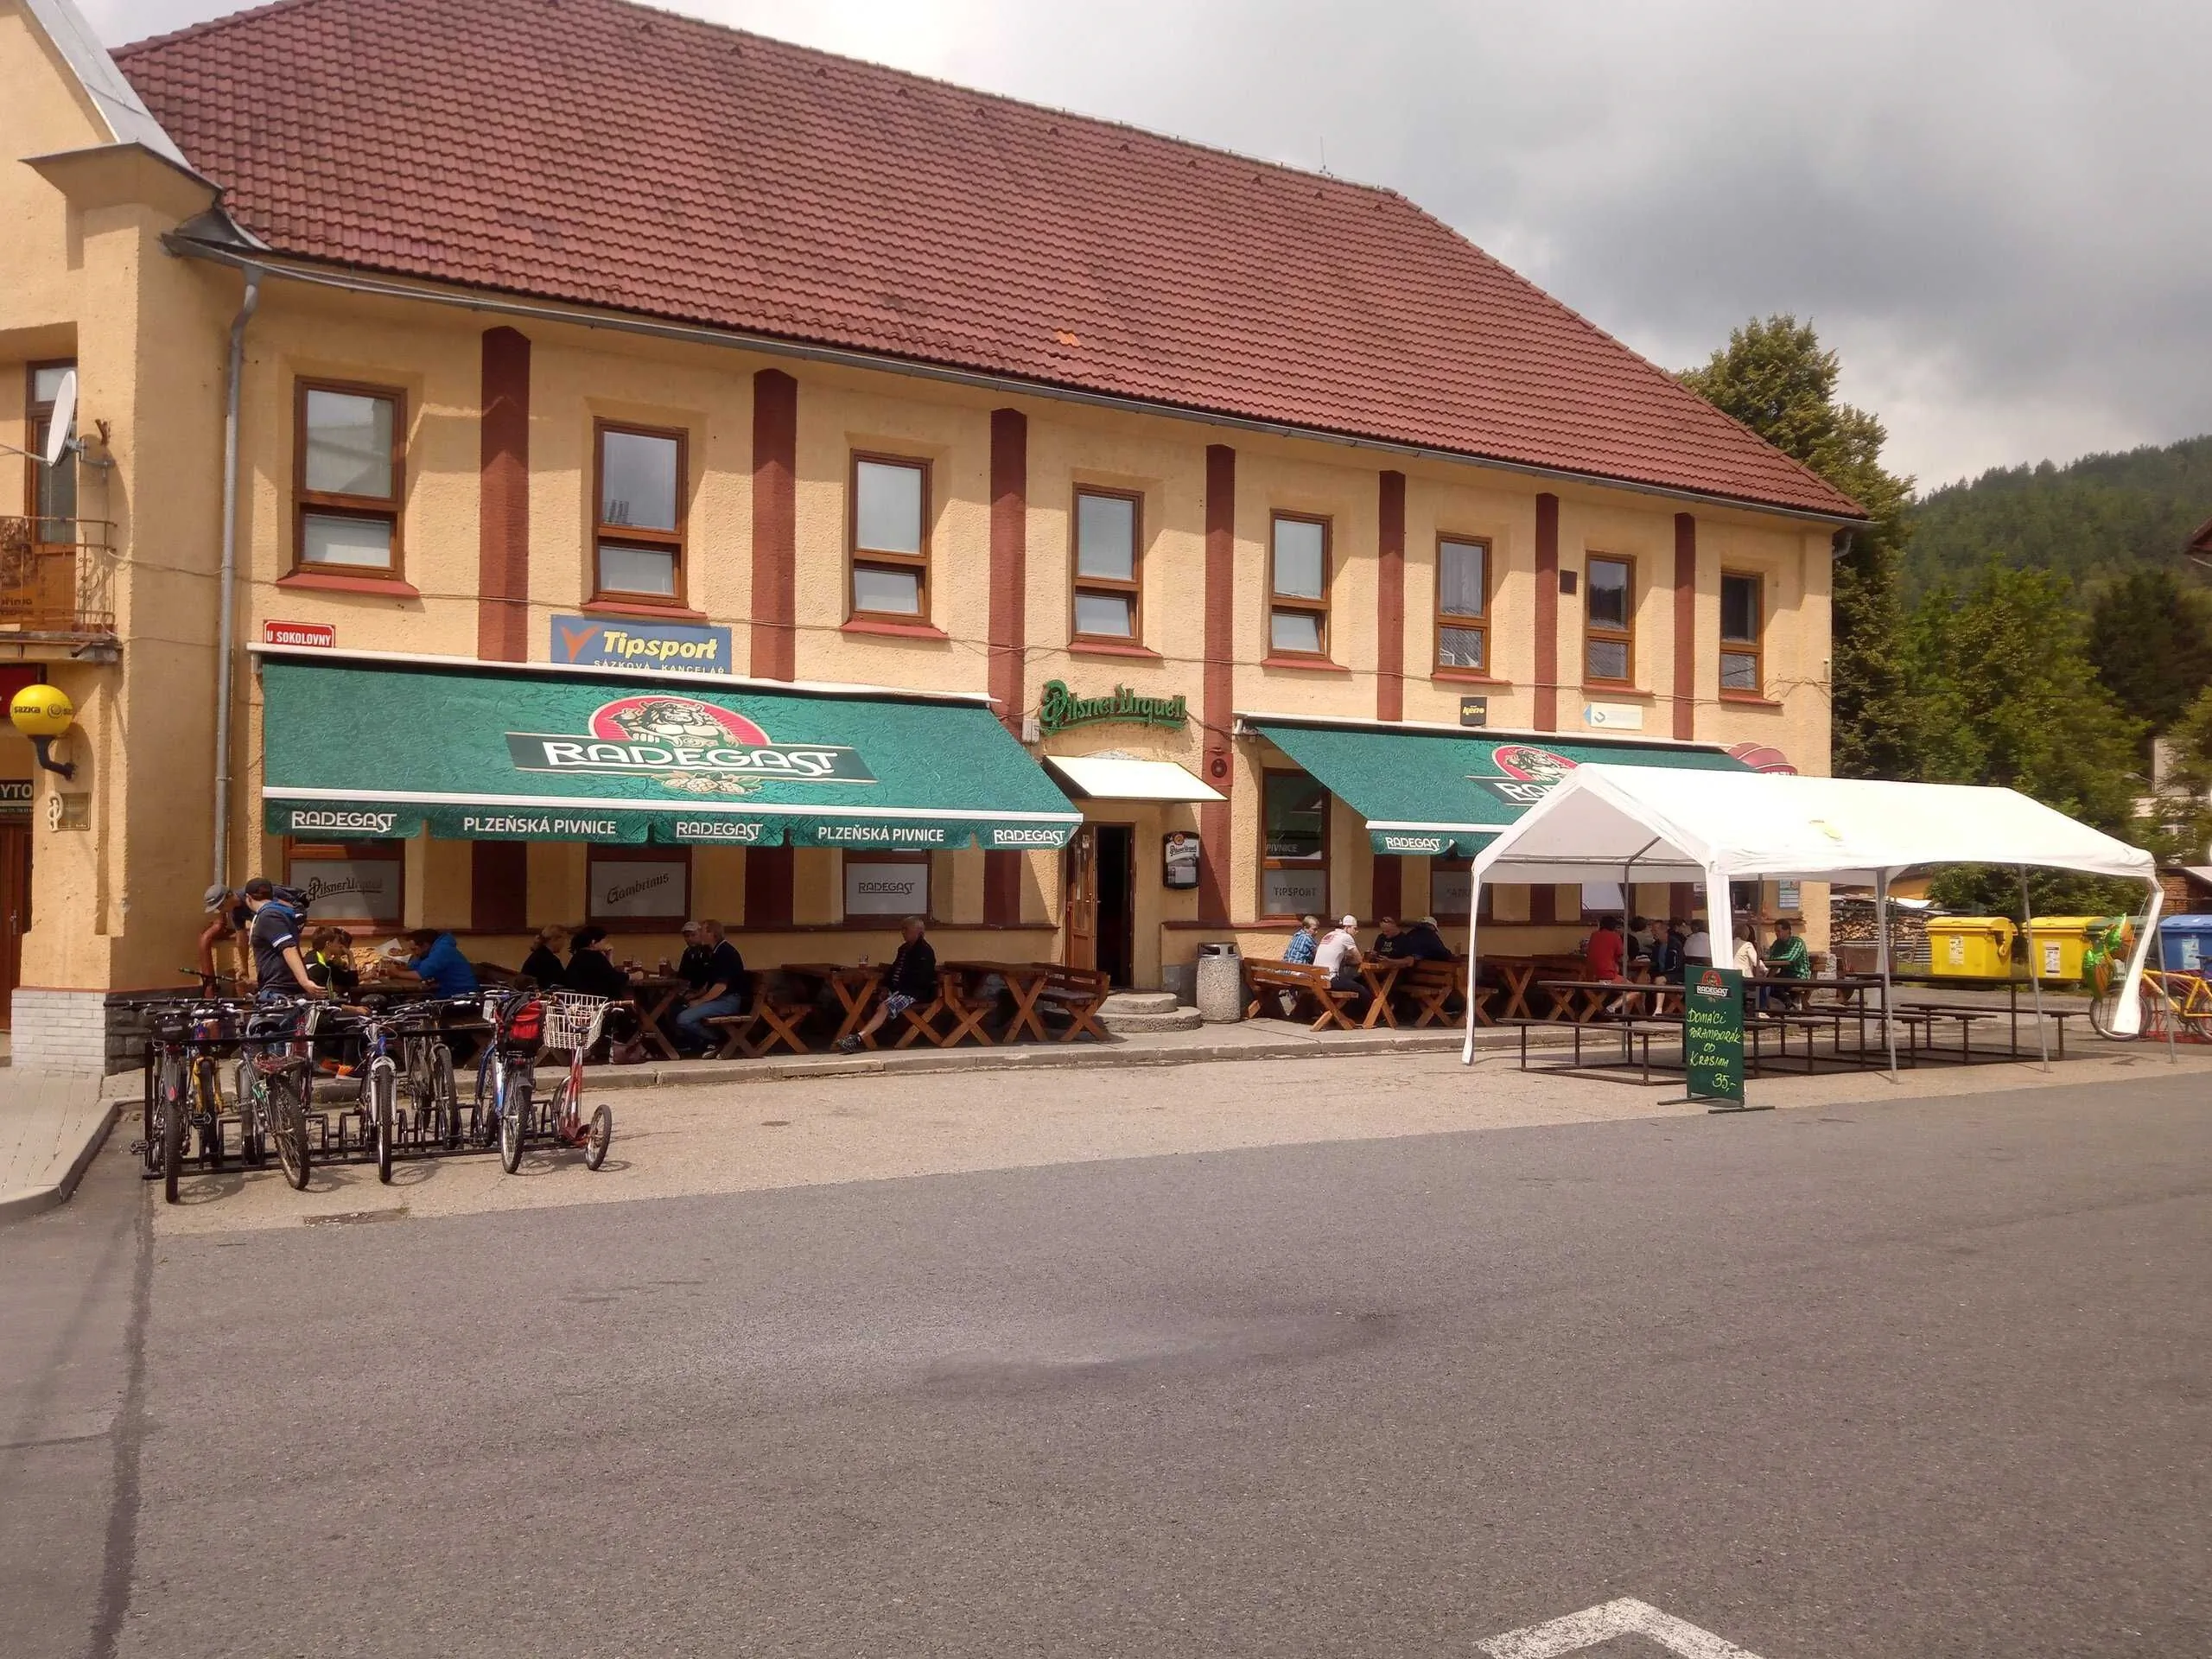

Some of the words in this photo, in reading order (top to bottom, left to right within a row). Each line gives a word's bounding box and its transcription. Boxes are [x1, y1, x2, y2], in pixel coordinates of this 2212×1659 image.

[267, 631, 273, 642] U
[276, 632, 331, 646] SOKOLOVNY
[603, 630, 718, 661] Tipsport
[1040, 679, 1116, 733] Pilsner
[1114, 683, 1187, 726] Urquell
[542, 741, 838, 775] RADEGAST
[291, 811, 397, 833] RADEGAST
[463, 816, 550, 834] PLZEŇSKÁ
[554, 819, 616, 835] PIVNICE
[676, 822, 764, 840] RADEGAST
[818, 825, 890, 842] PLZEŇSKÁ
[893, 828, 944, 842] PIVNICE
[994, 829, 1065, 844] RADEGAST
[1385, 836, 1441, 851] RADEGAST
[308, 876, 347, 901] Pilsner
[607, 873, 670, 905] Gambrinus
[858, 882, 916, 895] RADEGAST
[1274, 887, 1316, 896] TIPSPORT
[1696, 985, 1729, 997] RADEGAST
[1703, 1042, 1715, 1052] OD
